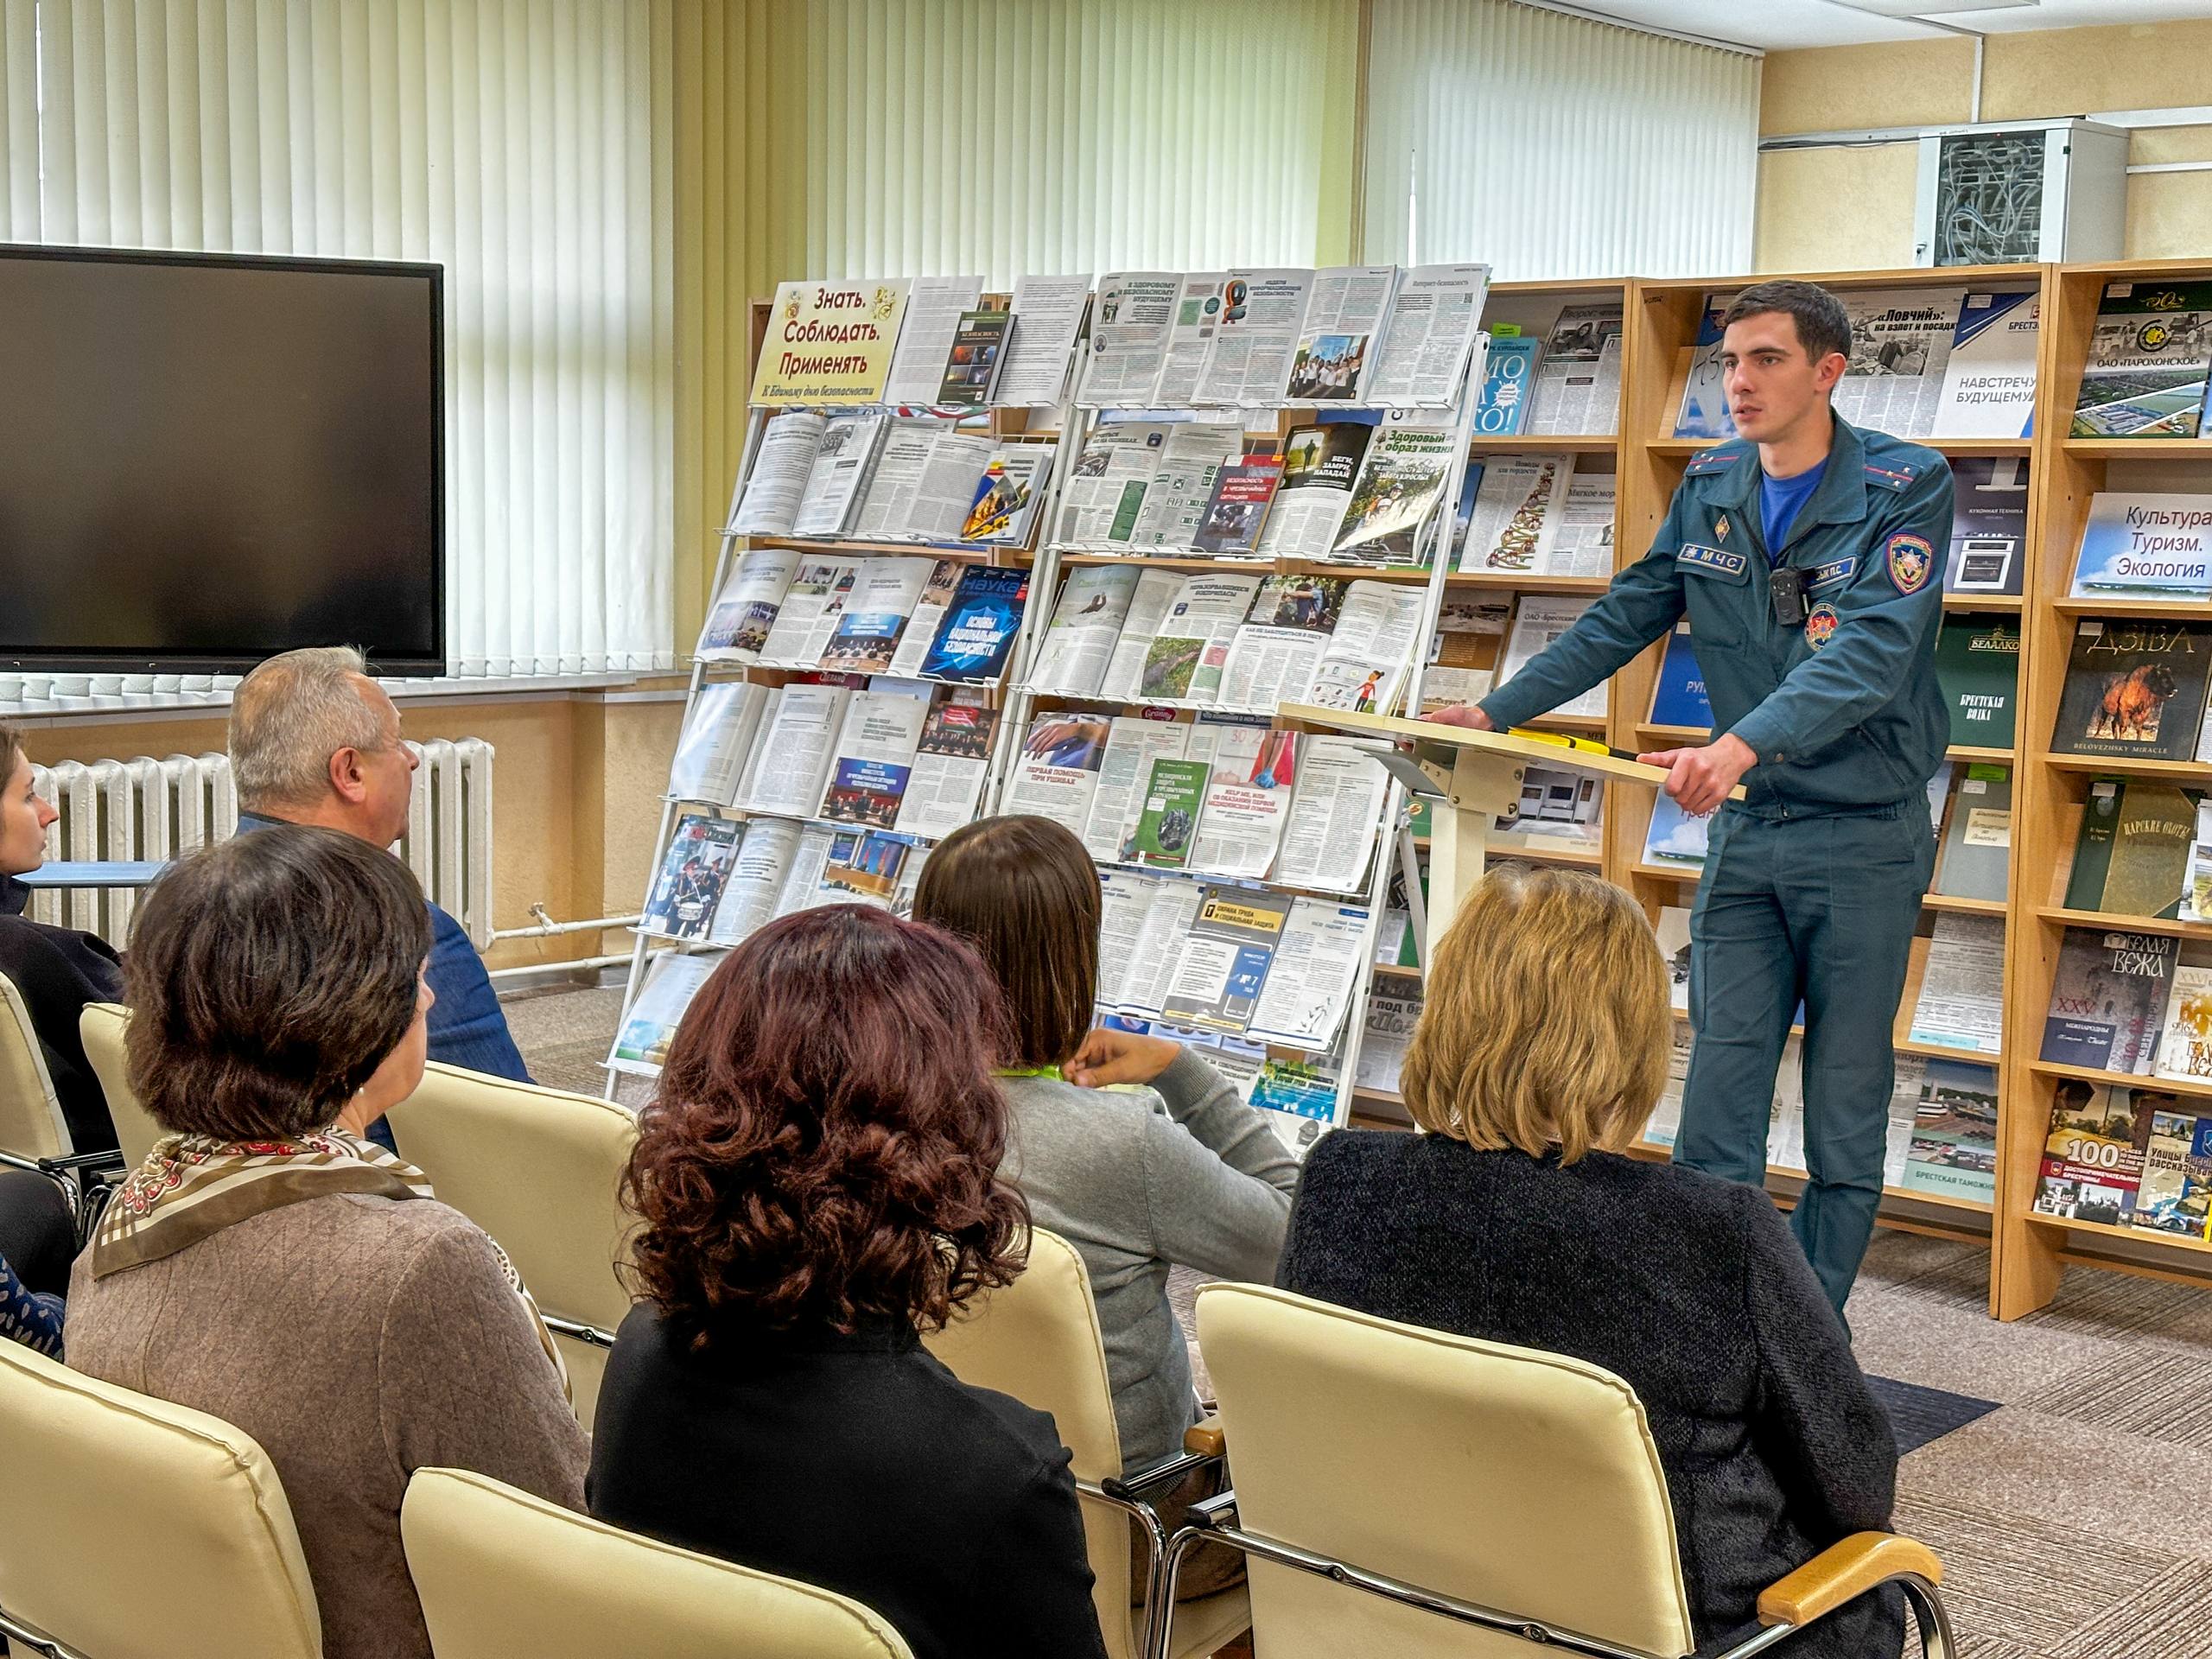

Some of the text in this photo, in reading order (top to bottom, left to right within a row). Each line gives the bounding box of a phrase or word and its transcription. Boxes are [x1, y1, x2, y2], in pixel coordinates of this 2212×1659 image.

[814, 287, 866, 310] Знать.
[784, 319, 880, 345] Соблюдать.
[1887, 322, 1913, 332] взлет
[779, 352, 868, 380] Применять
[2096, 356, 2201, 368] ОАО «ПАРОХОНСКОЕ»
[1959, 377, 2037, 389] НАВСТРЕЧУ
[762, 385, 875, 398] К Единому дню безопасности
[1389, 430, 1446, 444] Здоровый
[1385, 442, 1419, 454] образ
[2132, 531, 2203, 556] Туризм.
[1700, 550, 1738, 569] МЧС
[2116, 556, 2206, 578] Экология
[1960, 694, 2005, 709] БРЕСТСКАЯ
[1966, 709, 1992, 721] ВОДКА
[2133, 746, 2168, 754] MIRACLE
[1027, 766, 1085, 779] ПЕРВАЯ ПОМОЩЬ
[1217, 905, 1255, 918] ОХРАНА ТРУДА
[1254, 920, 1274, 929] ЗАЩИТА
[2111, 950, 2164, 978] ВЕЖА
[1251, 976, 1259, 986] 7
[1376, 1000, 1402, 1014] под
[2067, 1138, 2120, 1167] 100
[1916, 1171, 1957, 1184] БРЕСТСКАЯ
